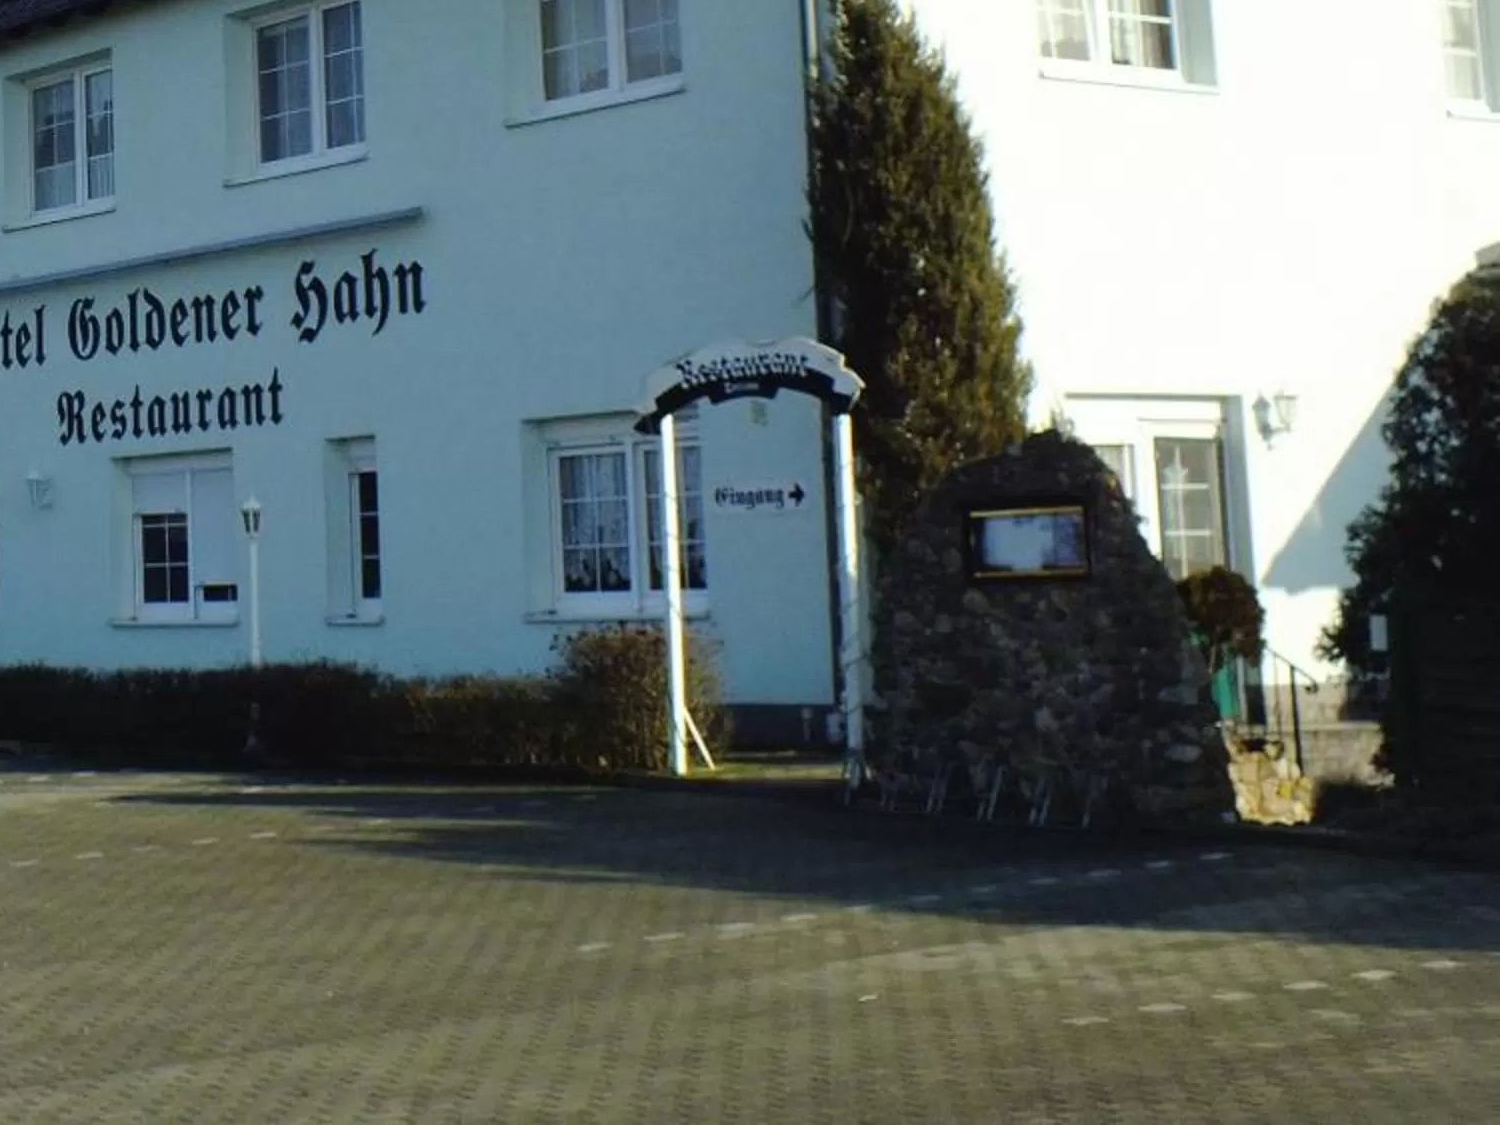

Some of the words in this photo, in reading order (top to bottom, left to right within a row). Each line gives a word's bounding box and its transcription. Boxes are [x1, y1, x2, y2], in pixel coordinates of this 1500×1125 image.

[67, 284, 264, 361] Goldener
[291, 248, 427, 343] Hahn
[57, 367, 284, 446] Restaurant
[714, 486, 784, 511] Eingang
